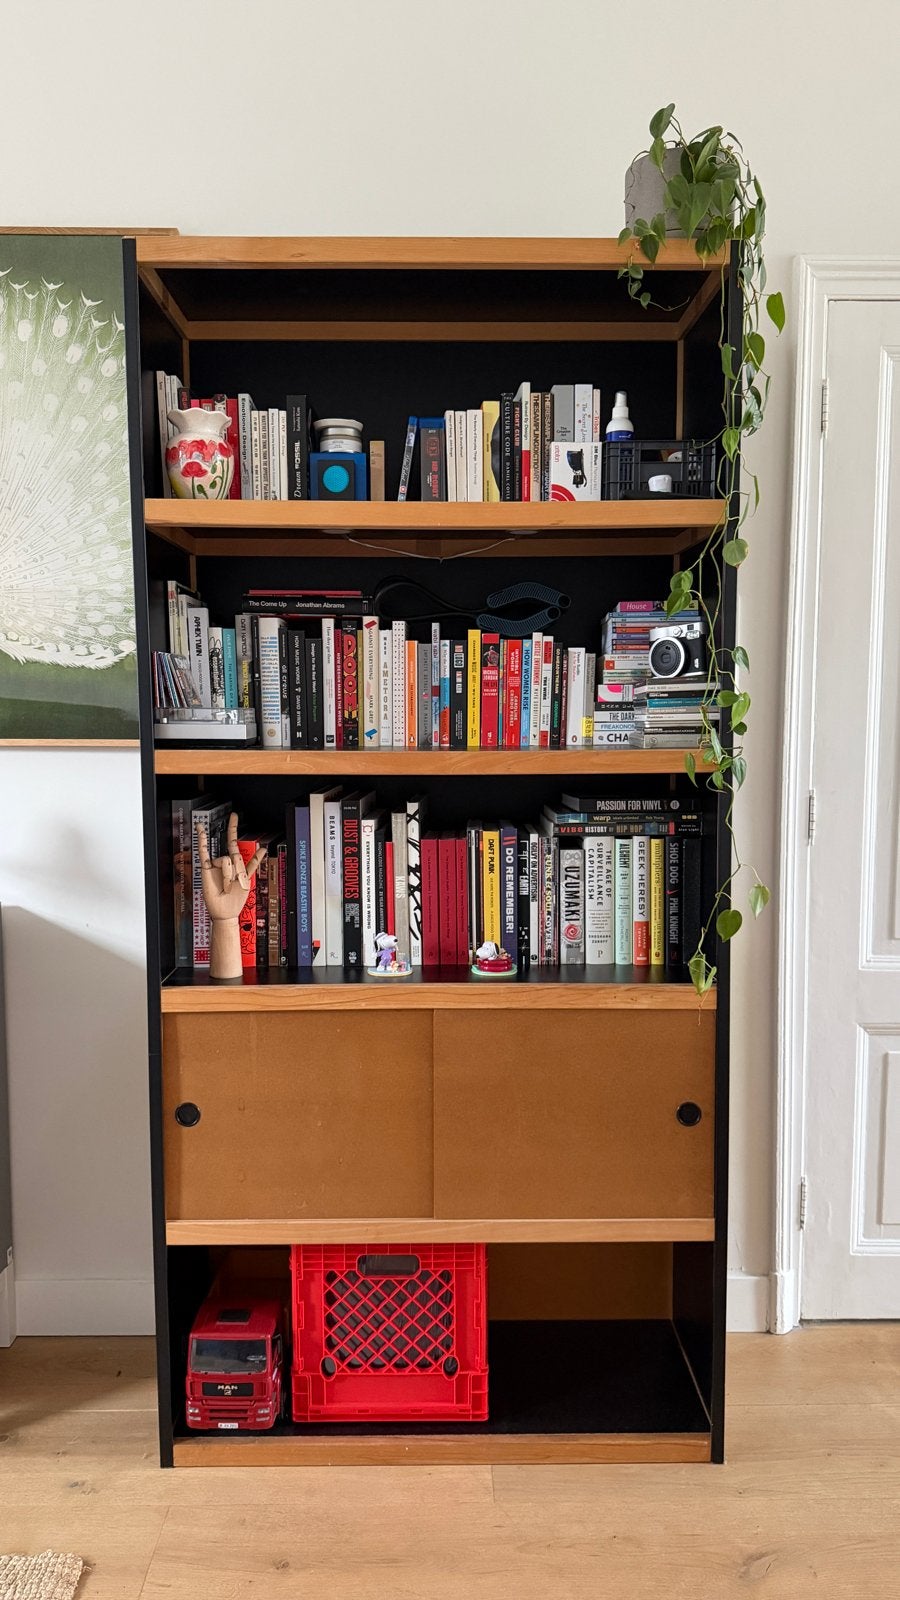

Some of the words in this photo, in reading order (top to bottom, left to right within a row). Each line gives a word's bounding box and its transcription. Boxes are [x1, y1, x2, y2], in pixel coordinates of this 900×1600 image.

[455, 654, 463, 667] LOGO
[609, 712, 620, 721] THE
[596, 800, 626, 811] PASSION
[628, 800, 641, 810] FOR
[642, 800, 661, 810] VINYL
[344, 819, 358, 843] DUST
[630, 824, 642, 832] HOP
[345, 846, 357, 854] &
[506, 848, 513, 863] DO
[619, 843, 630, 868] ALCHEMY
[669, 842, 679, 864] SHOE
[653, 843, 663, 884] multipliers
[344, 856, 359, 898] GROOVES
[519, 875, 529, 895] EARTH
[669, 866, 679, 884] DOG
[395, 875, 405, 898] KAWS
[565, 866, 580, 921] UZUMAKI
[606, 888, 612, 898] OF
[506, 866, 514, 933] REMEMBER!
[669, 897, 679, 913] PHIL
[669, 915, 679, 944] KNIGHT
